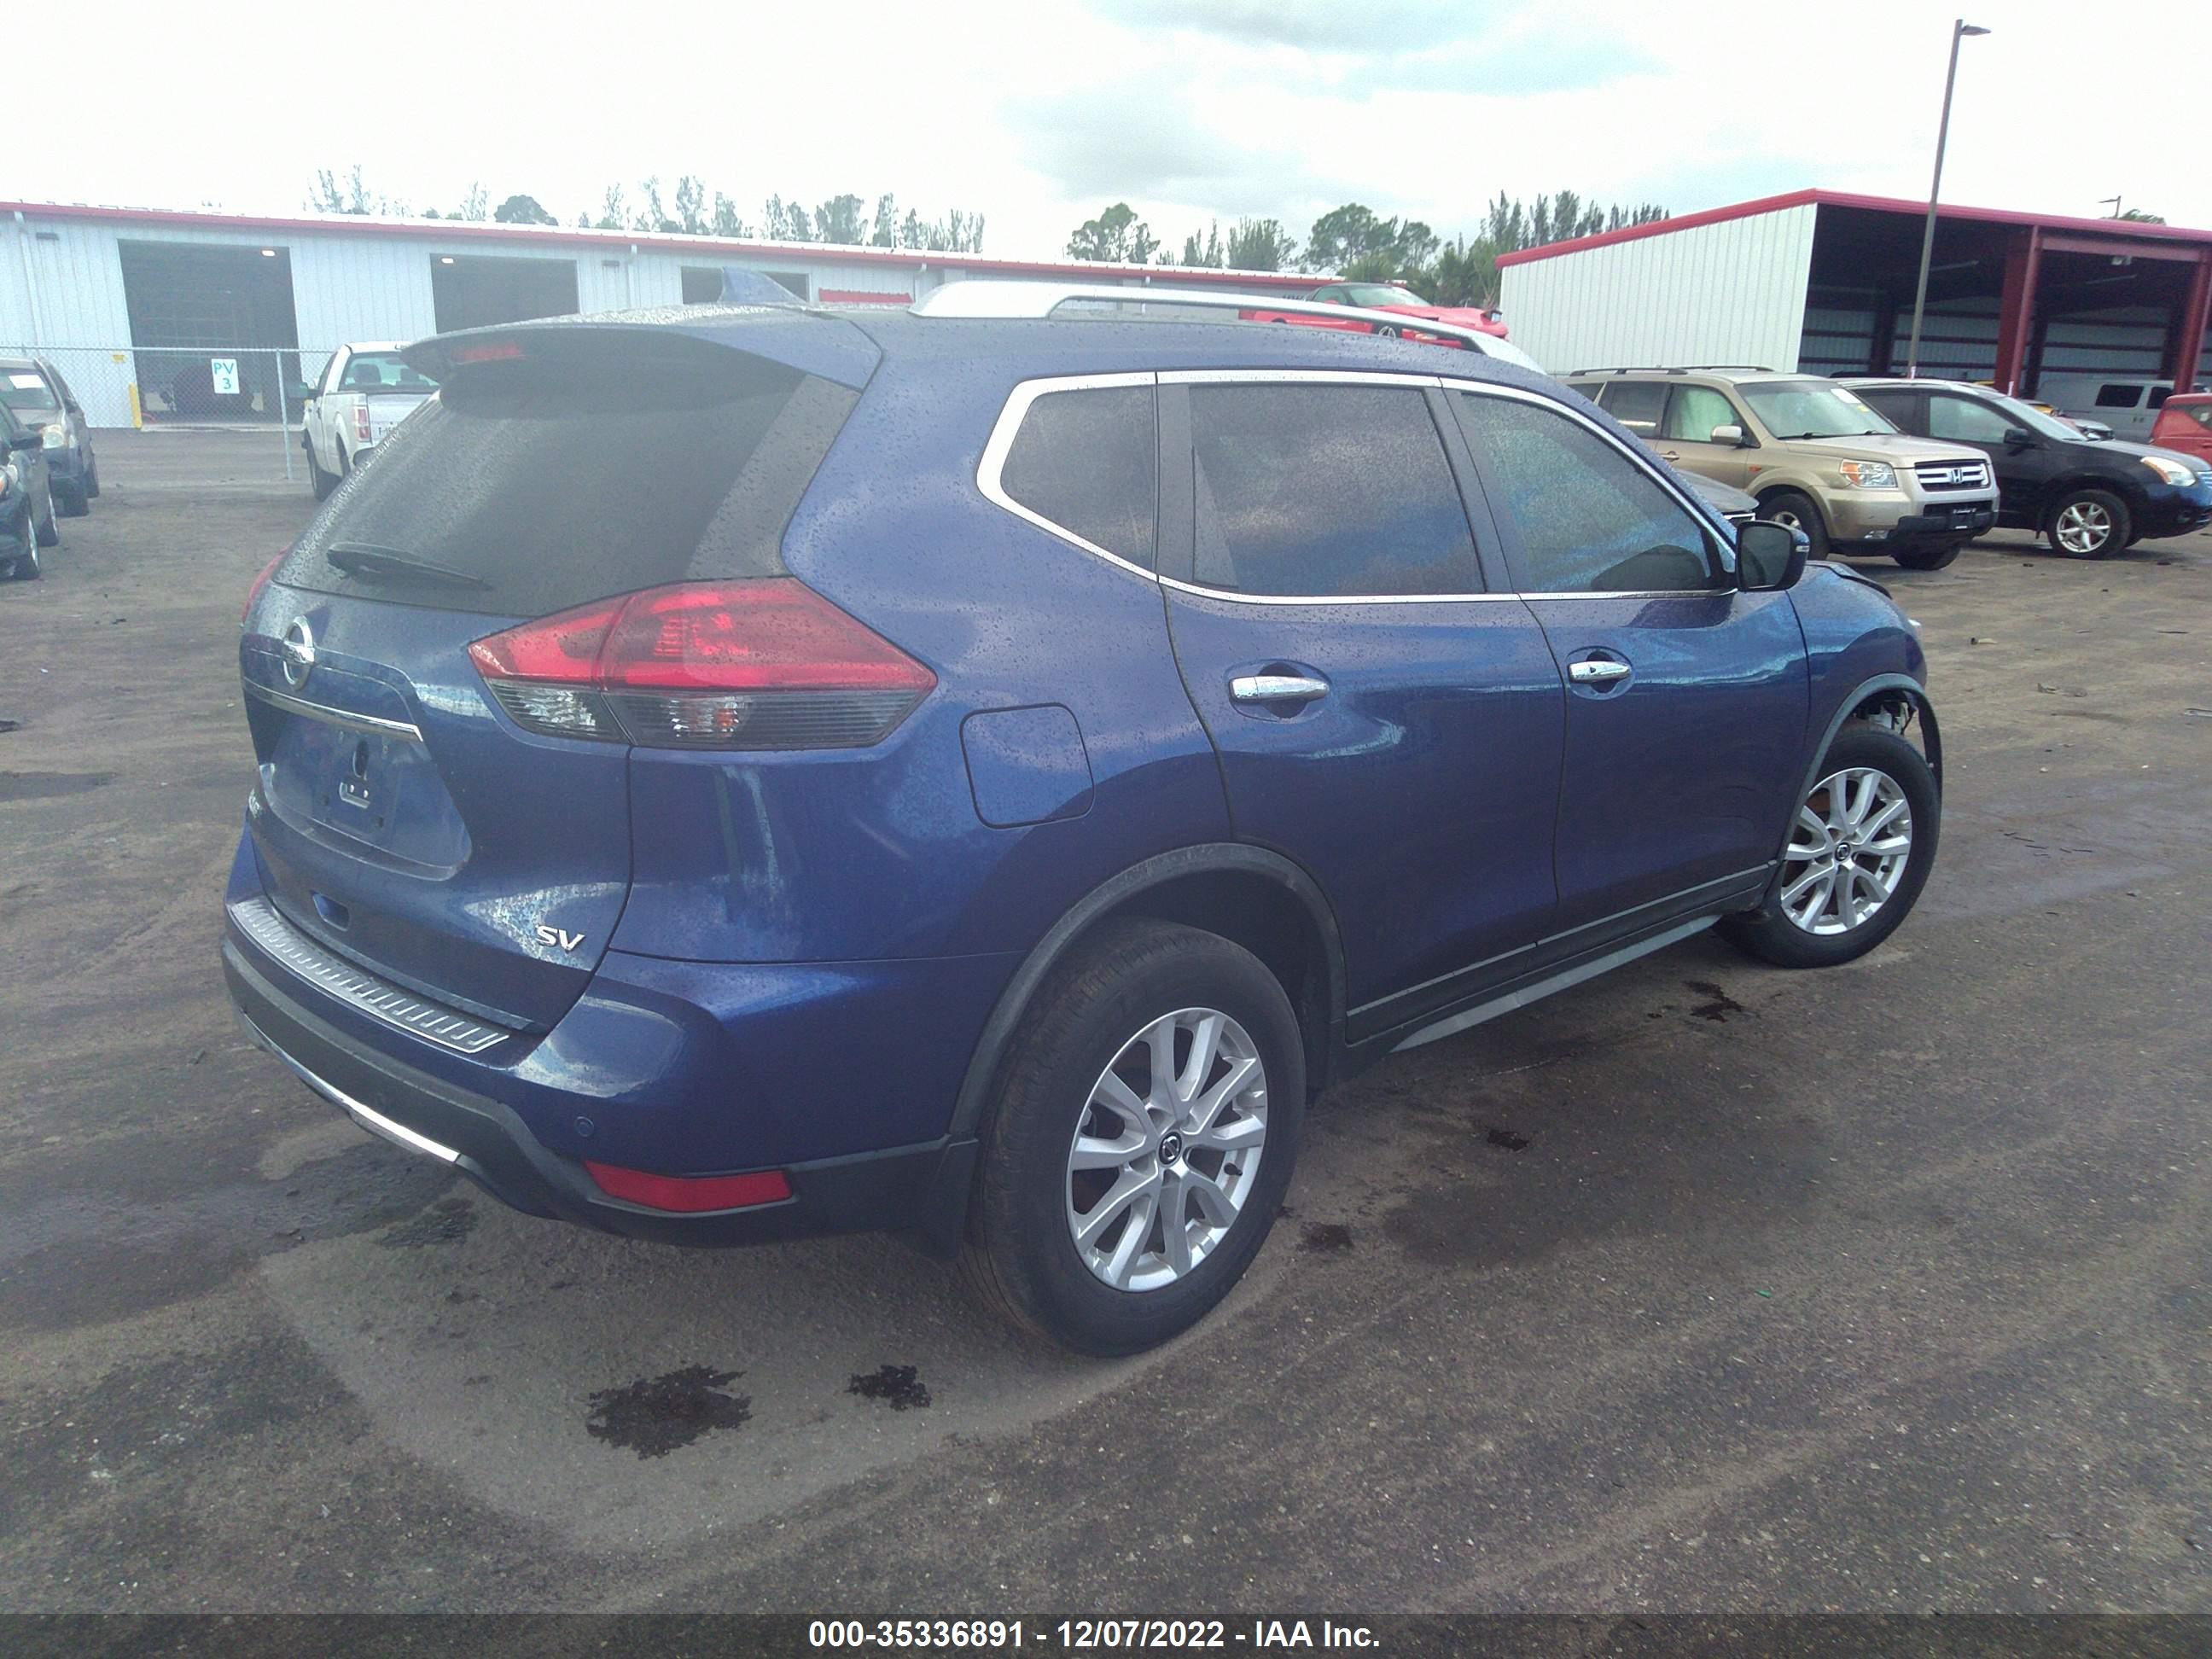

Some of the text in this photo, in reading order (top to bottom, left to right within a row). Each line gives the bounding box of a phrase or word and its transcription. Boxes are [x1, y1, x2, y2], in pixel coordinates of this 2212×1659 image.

[213, 363, 235, 375] PV
[223, 377, 231, 390] 3
[535, 924, 585, 952] SV
